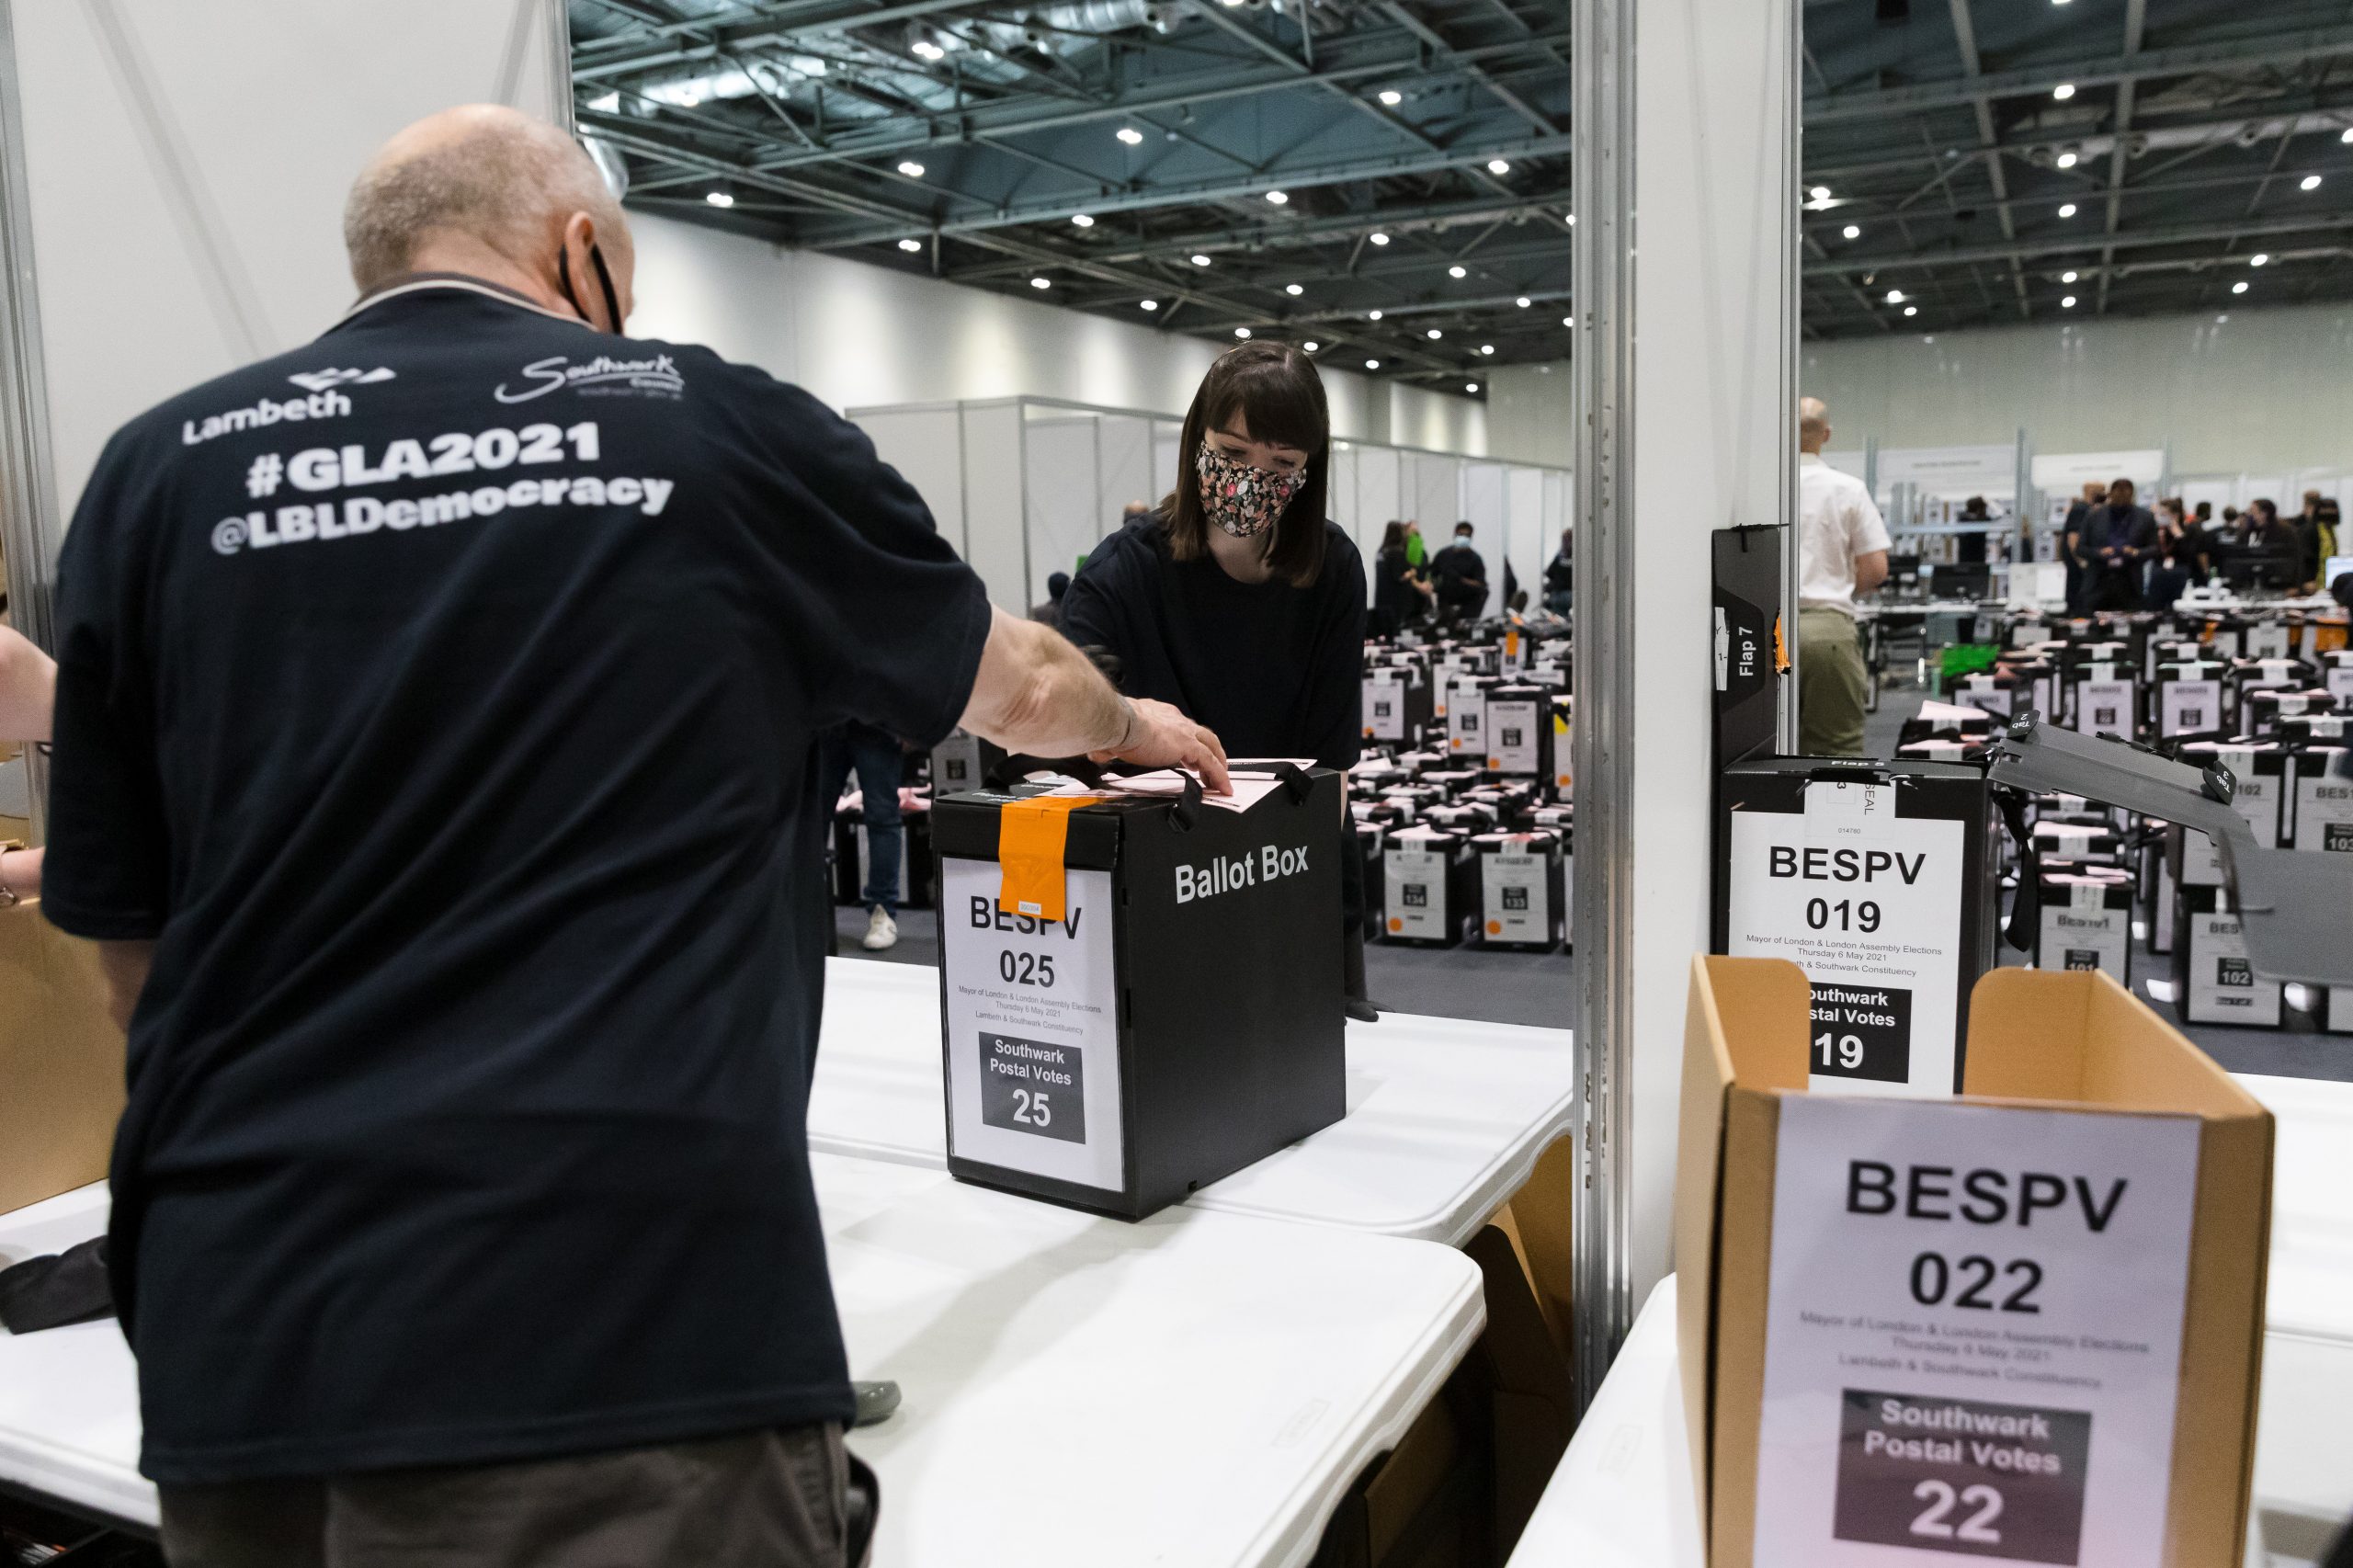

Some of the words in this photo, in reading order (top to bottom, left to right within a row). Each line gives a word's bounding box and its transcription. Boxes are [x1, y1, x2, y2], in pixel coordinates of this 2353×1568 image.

[494, 353, 683, 404] Southwark
[181, 389, 351, 446] Lambeth
[245, 421, 601, 499] #GLA2021
[210, 472, 674, 556] @LBLDemocracy
[1738, 626, 1753, 636] 7
[1739, 641, 1756, 676] Flap
[2012, 721, 2029, 729] Tab
[2216, 775, 2231, 793] Tab
[2222, 770, 2230, 779] 3
[1864, 783, 1875, 815] SEAL
[1175, 851, 1255, 904] Ballot
[1261, 843, 1309, 881] Box
[1769, 846, 1927, 885] BESPV
[1805, 897, 1881, 934] 019
[1745, 934, 1771, 944] Mayor
[1784, 937, 1814, 946] London
[1817, 938, 1823, 947] &
[1825, 939, 1857, 949] London
[1859, 942, 1901, 953] Assembly
[1903, 945, 1942, 956] Elections
[1797, 948, 1836, 959] Thursday
[1837, 949, 1844, 958] 6
[1846, 950, 1864, 961] May
[1866, 952, 1887, 961] 2021
[999, 949, 1055, 988] 025
[1815, 961, 1859, 971] Southwark
[1861, 965, 1916, 977] Constituency
[2222, 971, 2250, 984] 102
[959, 985, 976, 997] Mayor
[978, 987, 984, 996] of
[985, 989, 1008, 999] London
[1016, 994, 1039, 1005] London
[1040, 997, 1070, 1010] Assembly
[1072, 1002, 1101, 1014] Elections
[995, 1000, 1024, 1013] Thursday
[1025, 1005, 1029, 1013] 6
[1030, 1006, 1045, 1017] May
[1046, 1008, 1061, 1018] 2021
[1810, 988, 1888, 1006] outhwark
[975, 1010, 1002, 1022] Lambeth
[1003, 1014, 1008, 1022] &
[1009, 1016, 1041, 1028] Southwark
[1042, 1020, 1084, 1035] Constituency
[1809, 1006, 1840, 1022] stal
[1844, 1008, 1895, 1028] Votes
[995, 1039, 1064, 1065] Southwark
[1814, 1032, 1864, 1069] 19
[989, 1058, 1029, 1080] Postal
[1033, 1064, 1072, 1086] Votes
[1012, 1088, 1051, 1127] 25
[1846, 1159, 2128, 1233] BESPV
[1908, 1250, 2043, 1313] 022
[1799, 1311, 1845, 1329] Mayor
[1868, 1317, 1921, 1334] London
[1942, 1323, 1998, 1341] London
[2079, 1335, 2150, 1354] Elections
[1922, 1359, 2000, 1380] Southwark
[1880, 1398, 2050, 1440] Southwark
[1864, 1430, 1962, 1464] Postal
[1972, 1440, 2062, 1475] Votes
[1908, 1480, 2004, 1544] 22
